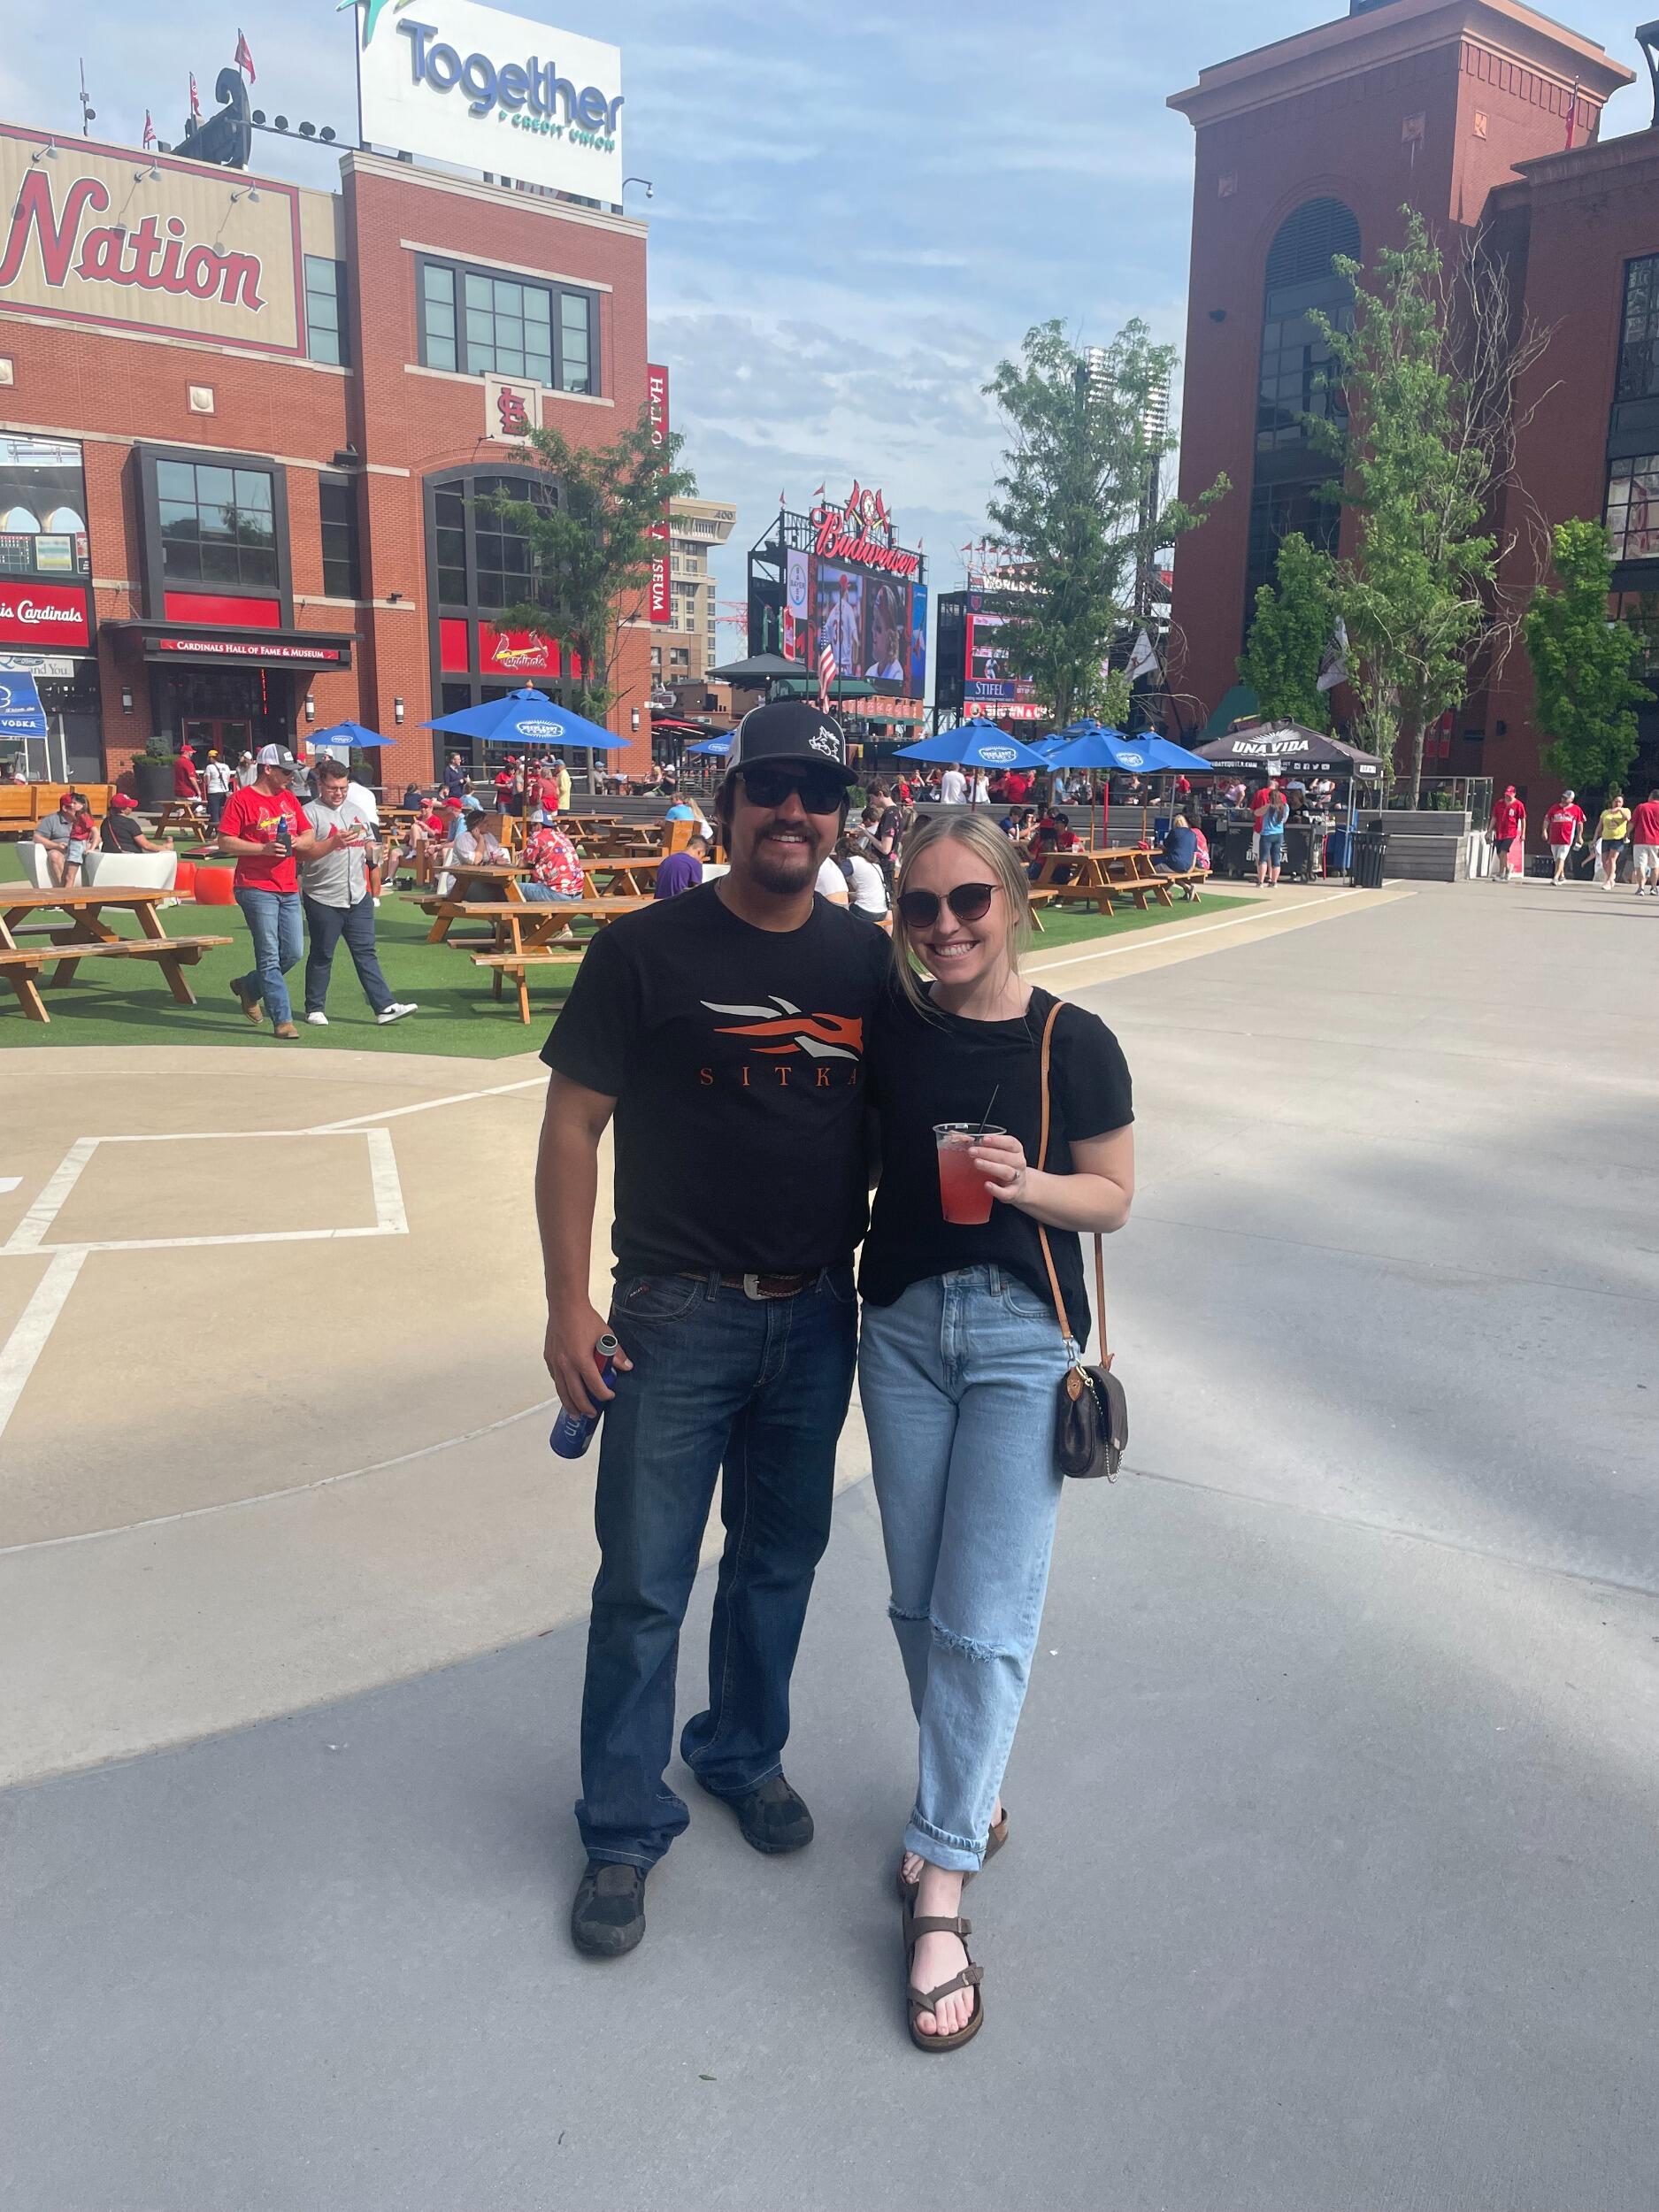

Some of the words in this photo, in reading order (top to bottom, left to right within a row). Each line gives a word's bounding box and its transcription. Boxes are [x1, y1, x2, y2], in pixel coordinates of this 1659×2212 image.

[396, 18, 625, 135] Together
[511, 113, 565, 140] CREDIT
[569, 128, 615, 153] UNION
[0, 168, 268, 313] Nation
[811, 507, 920, 575] Budweiser
[18, 600, 83, 624] Cardinals
[975, 681, 1004, 696] STIFEL
[2, 719, 36, 728] VODKA
[1232, 741, 1267, 753] UNA
[1271, 740, 1309, 753] VIDA
[700, 1066, 857, 1087] SITKA
